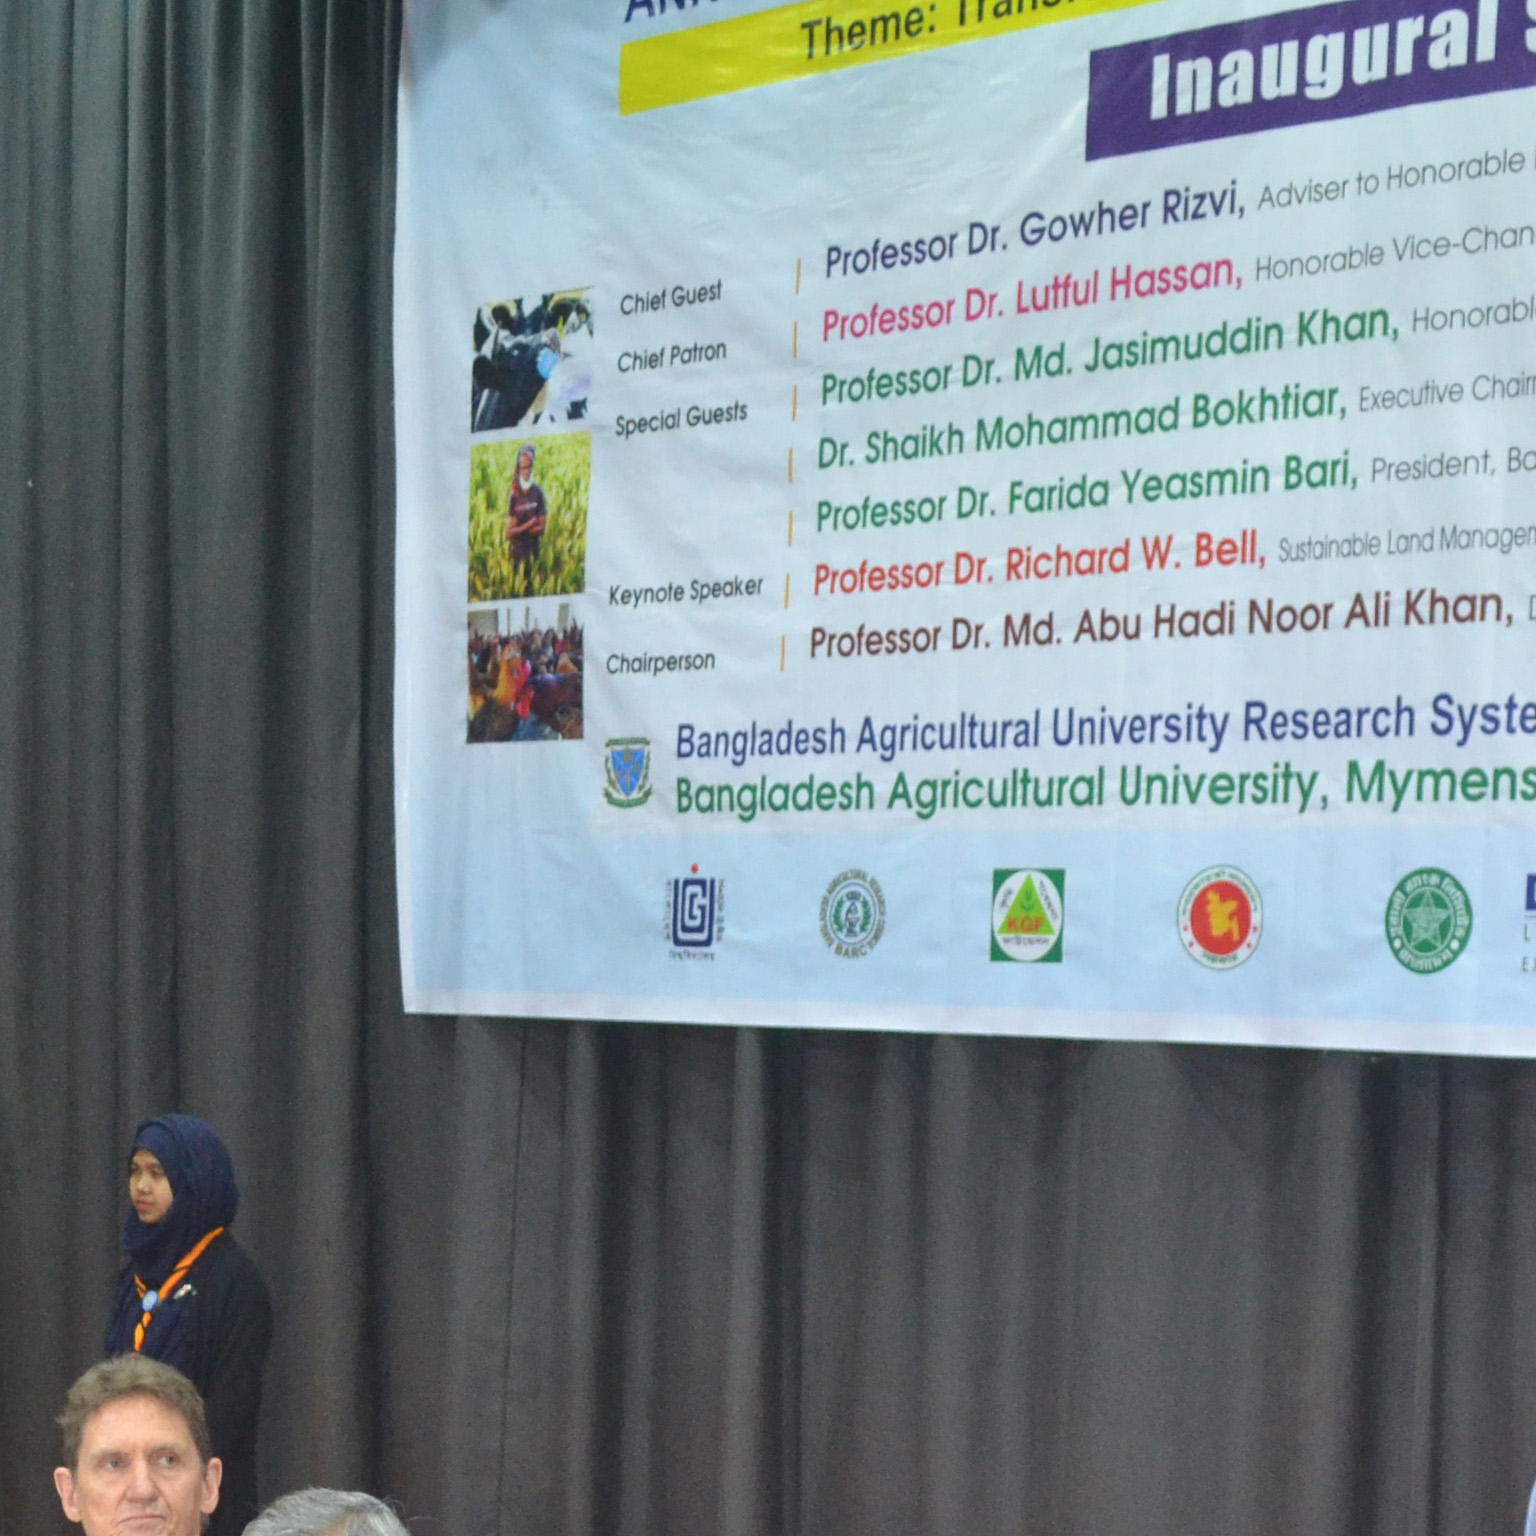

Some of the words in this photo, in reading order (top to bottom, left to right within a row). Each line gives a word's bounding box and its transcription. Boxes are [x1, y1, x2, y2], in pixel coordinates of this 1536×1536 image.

[801, 3, 937, 60] Theme:
[1151, 0, 1498, 121] Inaugural
[826, 231, 959, 279] Professor
[967, 221, 1008, 256] Dr.
[1019, 200, 1152, 247] Gowher
[1162, 178, 1245, 225] Rizvi,
[1256, 178, 1350, 211] Adviser
[1355, 170, 1380, 196] to
[1386, 147, 1527, 191] Honorable
[619, 287, 667, 316] Chief
[670, 278, 723, 308] Guest
[823, 298, 956, 343] Professor
[964, 287, 1004, 323] Dr.
[1016, 269, 1100, 315] Lutful
[1110, 258, 1241, 302] Hassan,
[1255, 241, 1386, 283] Honorable
[617, 346, 666, 374] Chief
[669, 341, 727, 366] Patron
[821, 364, 953, 406] Professor
[961, 353, 1002, 388] Dr.
[1014, 341, 1073, 382] Md.
[1084, 316, 1284, 373] Jasimuddin
[1297, 308, 1398, 348] Khan,
[614, 407, 681, 441] Special
[685, 400, 748, 428] Guests
[817, 436, 855, 470] Dr.
[864, 421, 965, 465] Shaikh
[975, 395, 1181, 452] Mohammad
[1191, 382, 1347, 429] Bokhtiar,
[1358, 378, 1465, 413] Executive
[817, 495, 948, 533] Professor
[956, 485, 996, 520] Dr.
[1008, 473, 1110, 515] Farida
[1120, 458, 1271, 505] Yeasmin
[1283, 449, 1358, 491] Bari,
[1371, 449, 1496, 484] President,
[608, 581, 686, 609] Keynote
[689, 575, 764, 605] Speaker
[813, 559, 945, 596] Professor
[953, 551, 993, 586] Dr.
[1005, 537, 1131, 582] Richard
[1141, 534, 1181, 571] W.
[1194, 528, 1266, 570] Bell,
[1278, 531, 1382, 564] Sustainable
[1386, 526, 1436, 556] Land
[810, 623, 942, 659] Professor
[951, 616, 991, 651] Dr.
[1003, 610, 1062, 648] Md.
[1072, 607, 1142, 644] Abu
[1153, 599, 1236, 639] Hadi
[1247, 597, 1334, 635] Noor
[1343, 590, 1391, 629] Ali
[1403, 587, 1513, 628] Khan,
[605, 651, 716, 677] Chairperson
[676, 717, 846, 768] Bangladesh
[855, 708, 1041, 763] Agricultural
[1052, 701, 1230, 754] University
[1243, 694, 1416, 742] Research
[676, 771, 875, 824] Bangladesh
[886, 765, 1106, 821] Agricultural
[1119, 761, 1328, 815] University,
